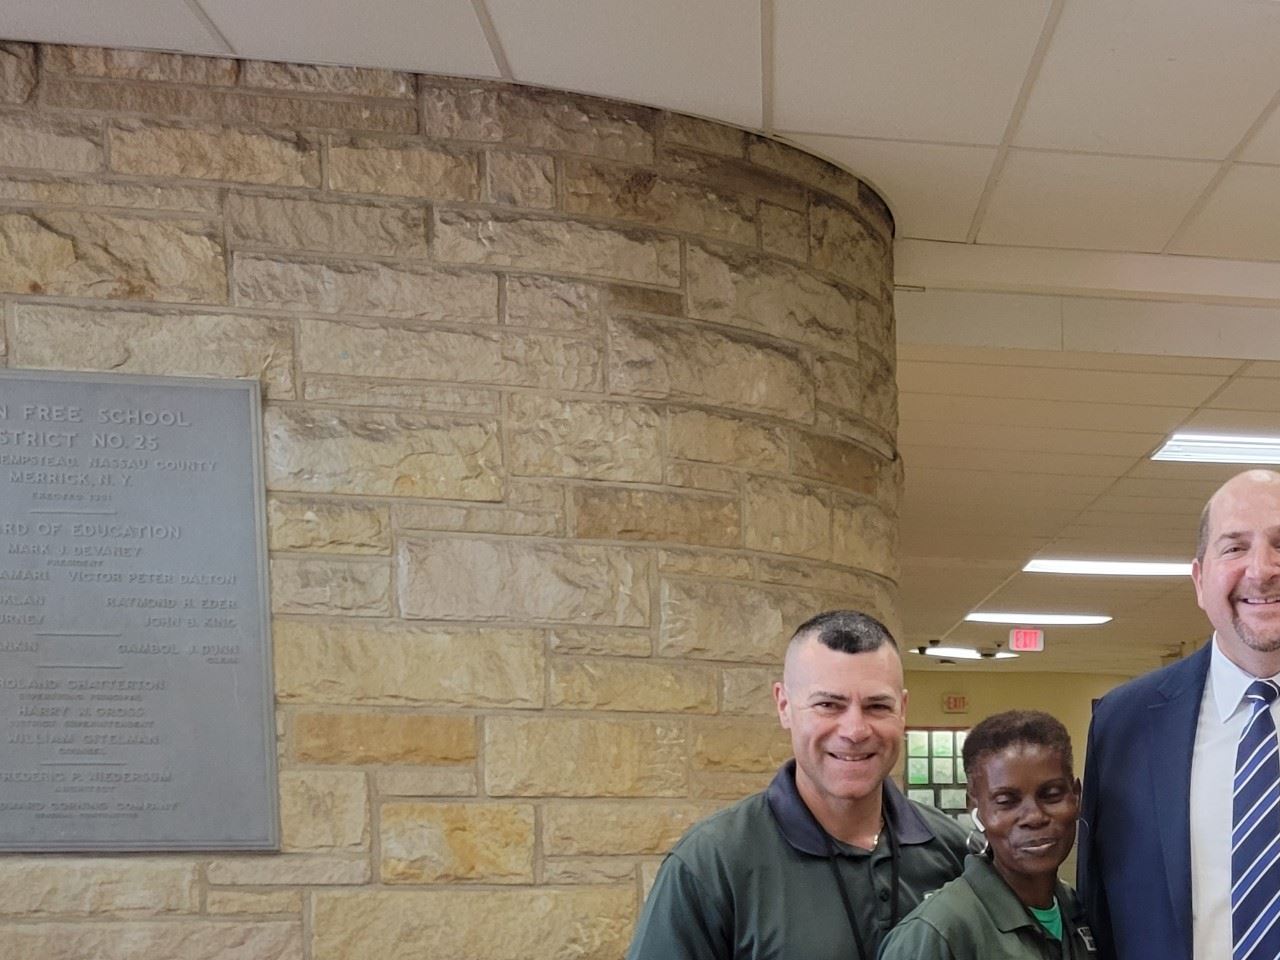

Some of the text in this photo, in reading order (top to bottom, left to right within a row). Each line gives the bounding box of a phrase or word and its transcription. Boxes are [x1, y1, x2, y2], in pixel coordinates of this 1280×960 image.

[23, 405, 82, 423] FREE
[99, 408, 192, 427] SCHOOL
[89, 455, 149, 471] NASSAU
[156, 459, 218, 472] COUNTY
[36, 522, 63, 537] OF
[72, 523, 182, 540] EDUCATION
[8, 542, 50, 556] MARK
[67, 571, 237, 586] VICTOR PETER DALTON
